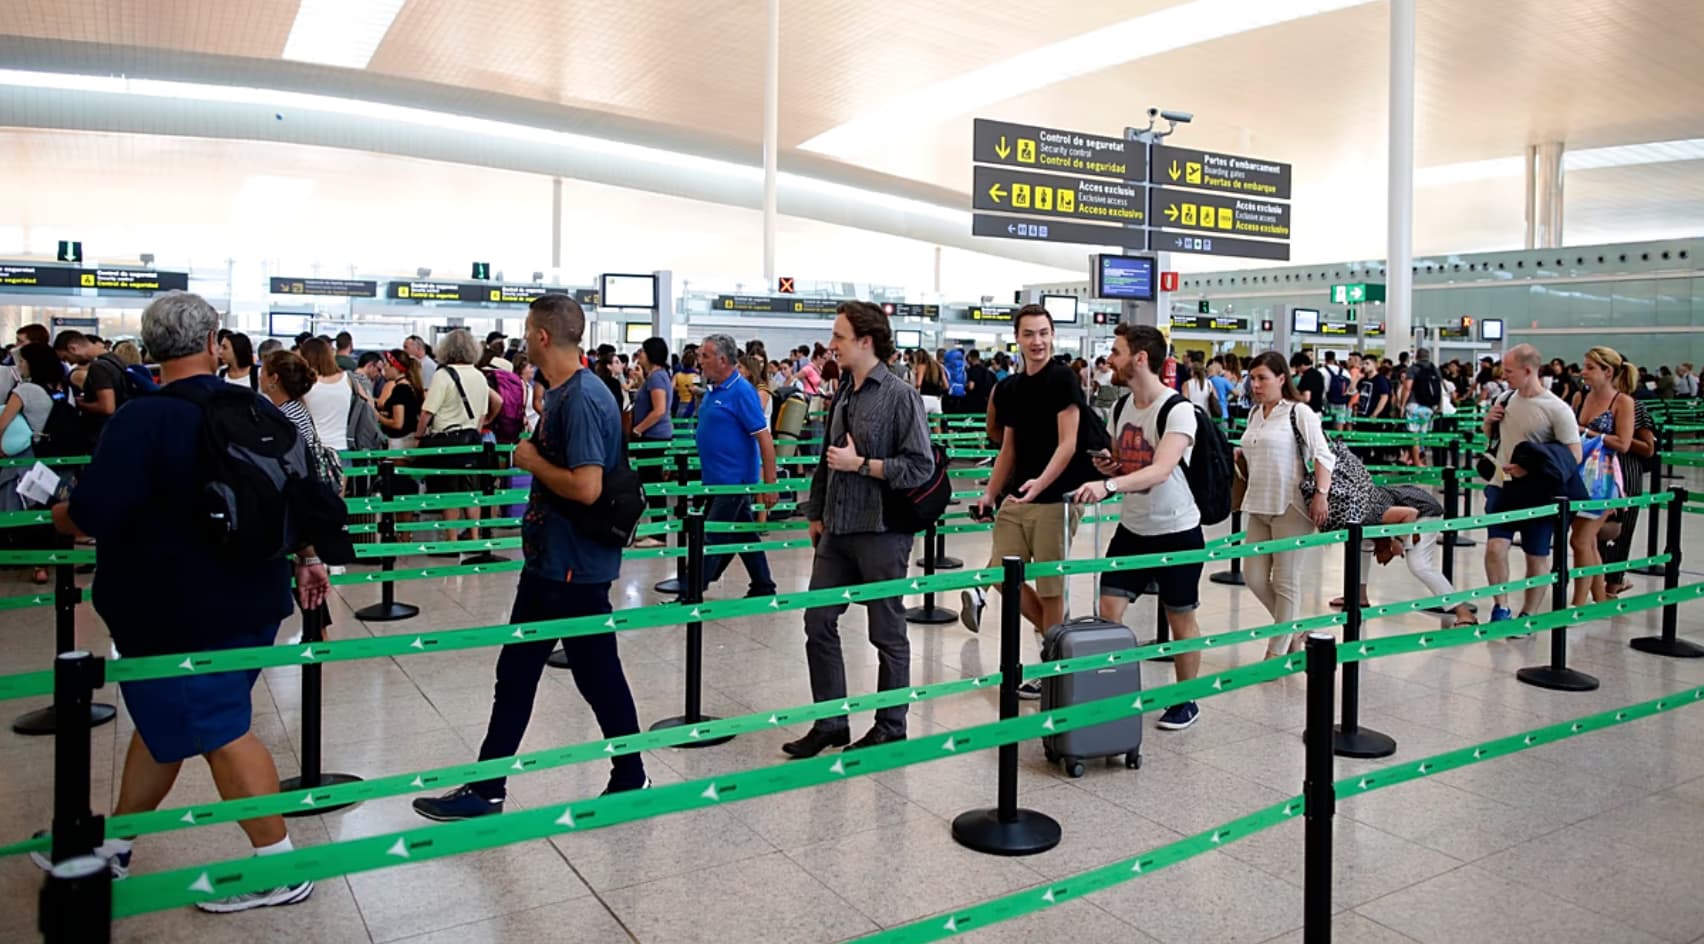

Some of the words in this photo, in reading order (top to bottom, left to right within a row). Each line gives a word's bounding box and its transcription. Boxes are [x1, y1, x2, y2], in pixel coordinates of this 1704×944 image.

[1040, 131, 1070, 144] Control
[1073, 136, 1083, 146] de
[1086, 140, 1124, 152] seguretat
[1040, 143, 1067, 156] Security
[1069, 148, 1092, 158] control
[1040, 154, 1070, 167] Control
[1073, 158, 1083, 168] de
[1086, 162, 1126, 174] seguridad
[1204, 175, 1231, 187] Puertas
[1233, 180, 1242, 188] de
[1243, 182, 1276, 192] embarque
[1079, 203, 1107, 215] Acceso
[1108, 208, 1143, 219] exclusivo
